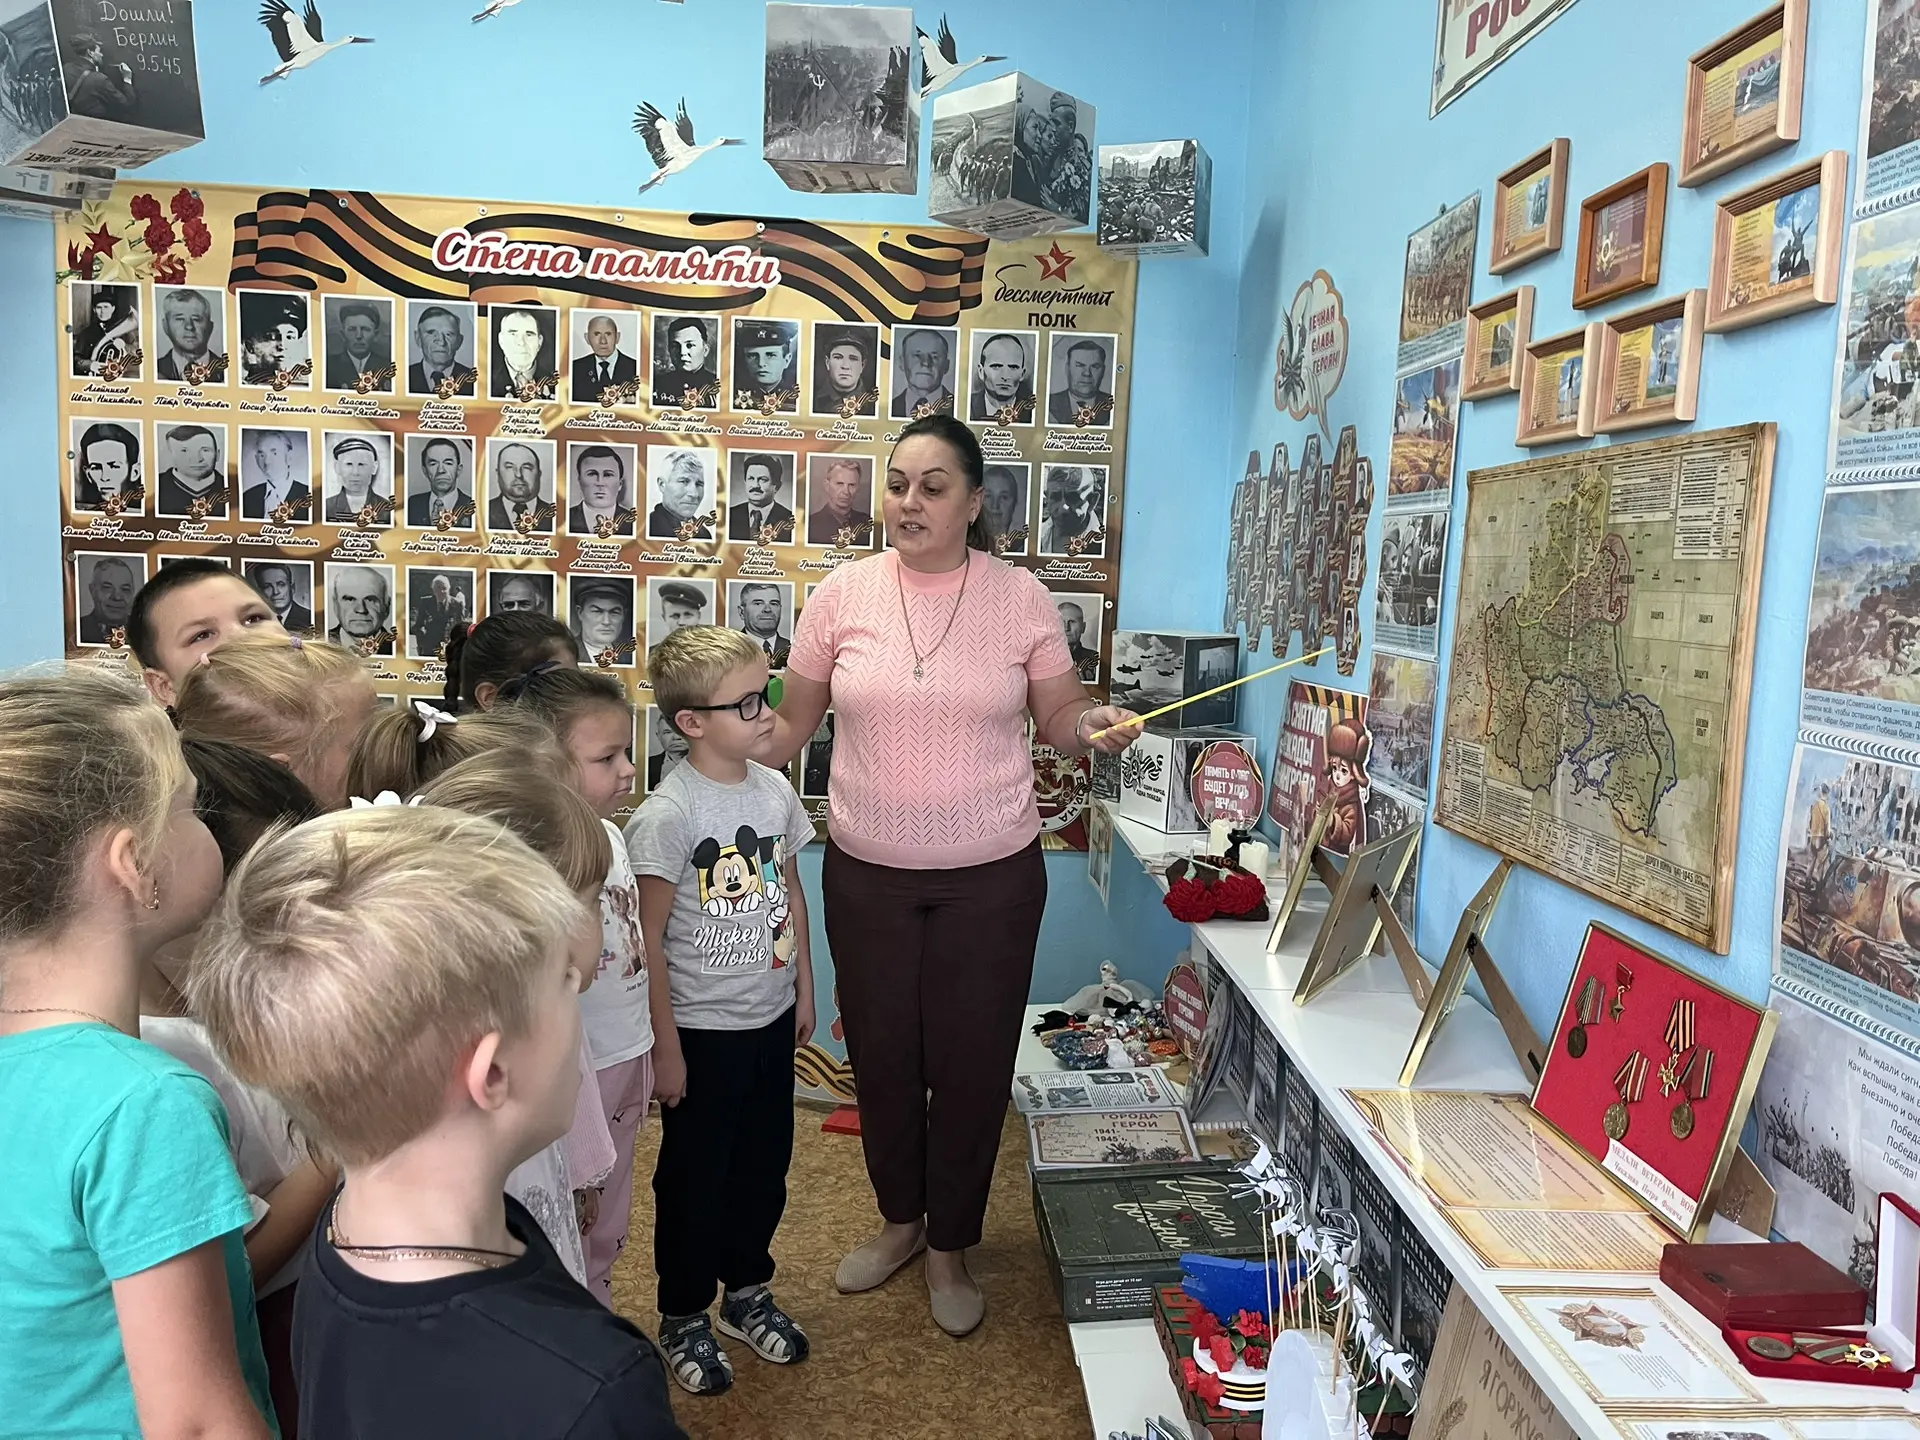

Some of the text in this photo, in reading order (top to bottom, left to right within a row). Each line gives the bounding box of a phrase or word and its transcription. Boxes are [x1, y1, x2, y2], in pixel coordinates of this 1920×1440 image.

[101, 0, 174, 24] Дошли!
[113, 27, 178, 50] Берлин
[137, 53, 182, 75] 9.5.45
[436, 232, 778, 284] Стена памяти
[994, 264, 1115, 307] бессмертный
[1027, 313, 1077, 329] ПОЛК
[1312, 330, 1334, 352] СЛАВА
[981, 449, 1022, 459] одионович
[1877, 703, 1891, 713] Союз
[1205, 766, 1229, 778] ПАМЯТЬ
[1204, 780, 1226, 794] БУДЕТ
[694, 922, 764, 949] Mickey
[707, 947, 768, 968] Mouse
[1858, 1047, 1872, 1062] Мы
[1873, 1056, 1899, 1075] ждали
[1848, 1059, 1915, 1104] Как вспышка, как
[1861, 1084, 1898, 1113] Внезапно
[1883, 1151, 1917, 1182] Победа!
[1641, 1161, 1675, 1199] ВЕТЕРАНА
[1680, 1192, 1696, 1214] ВОВ
[1156, 1175, 1236, 1237] Дороги
[1113, 1203, 1191, 1250] войны
